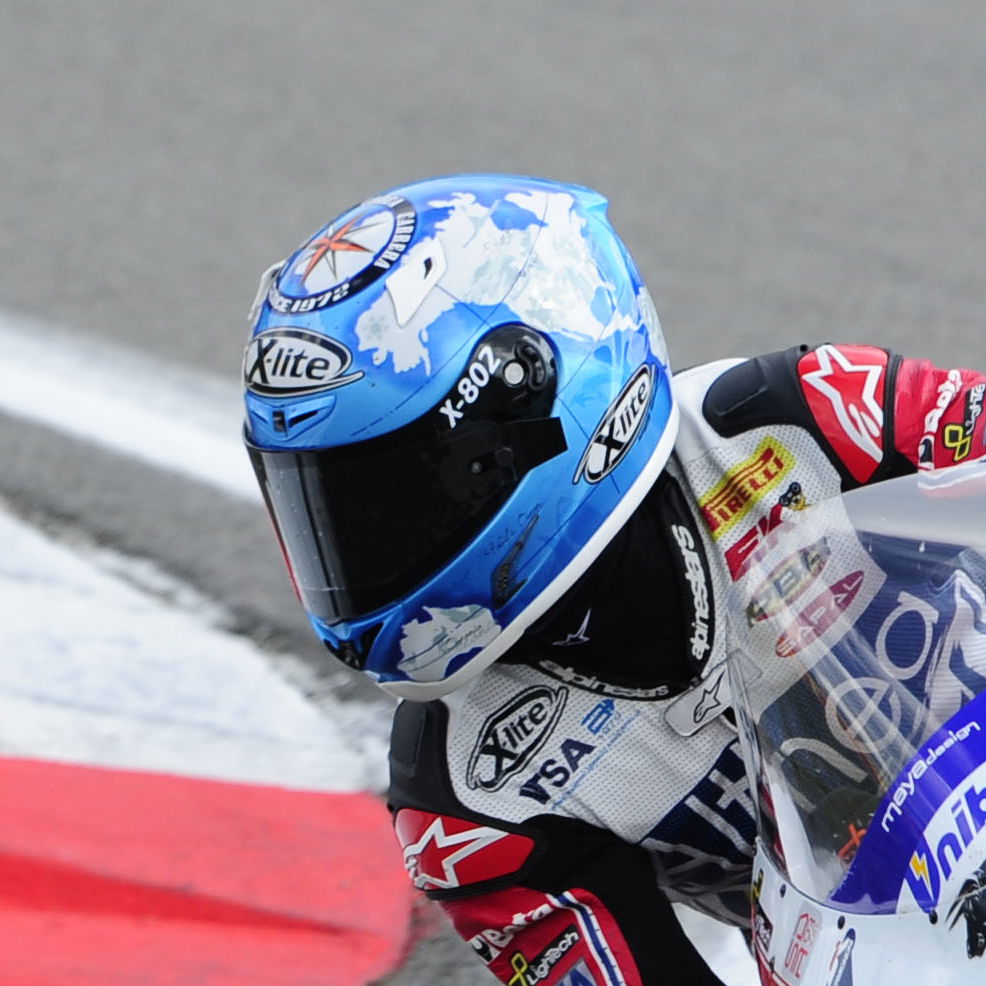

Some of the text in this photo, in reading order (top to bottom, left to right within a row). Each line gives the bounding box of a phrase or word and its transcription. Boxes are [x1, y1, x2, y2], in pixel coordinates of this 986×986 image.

[438, 345, 502, 429] X-802
[701, 447, 784, 532] PIRELLI
[671, 524, 711, 661] alpinestars
[778, 572, 864, 656] SAPAL
[538, 660, 670, 698] alpinestars
